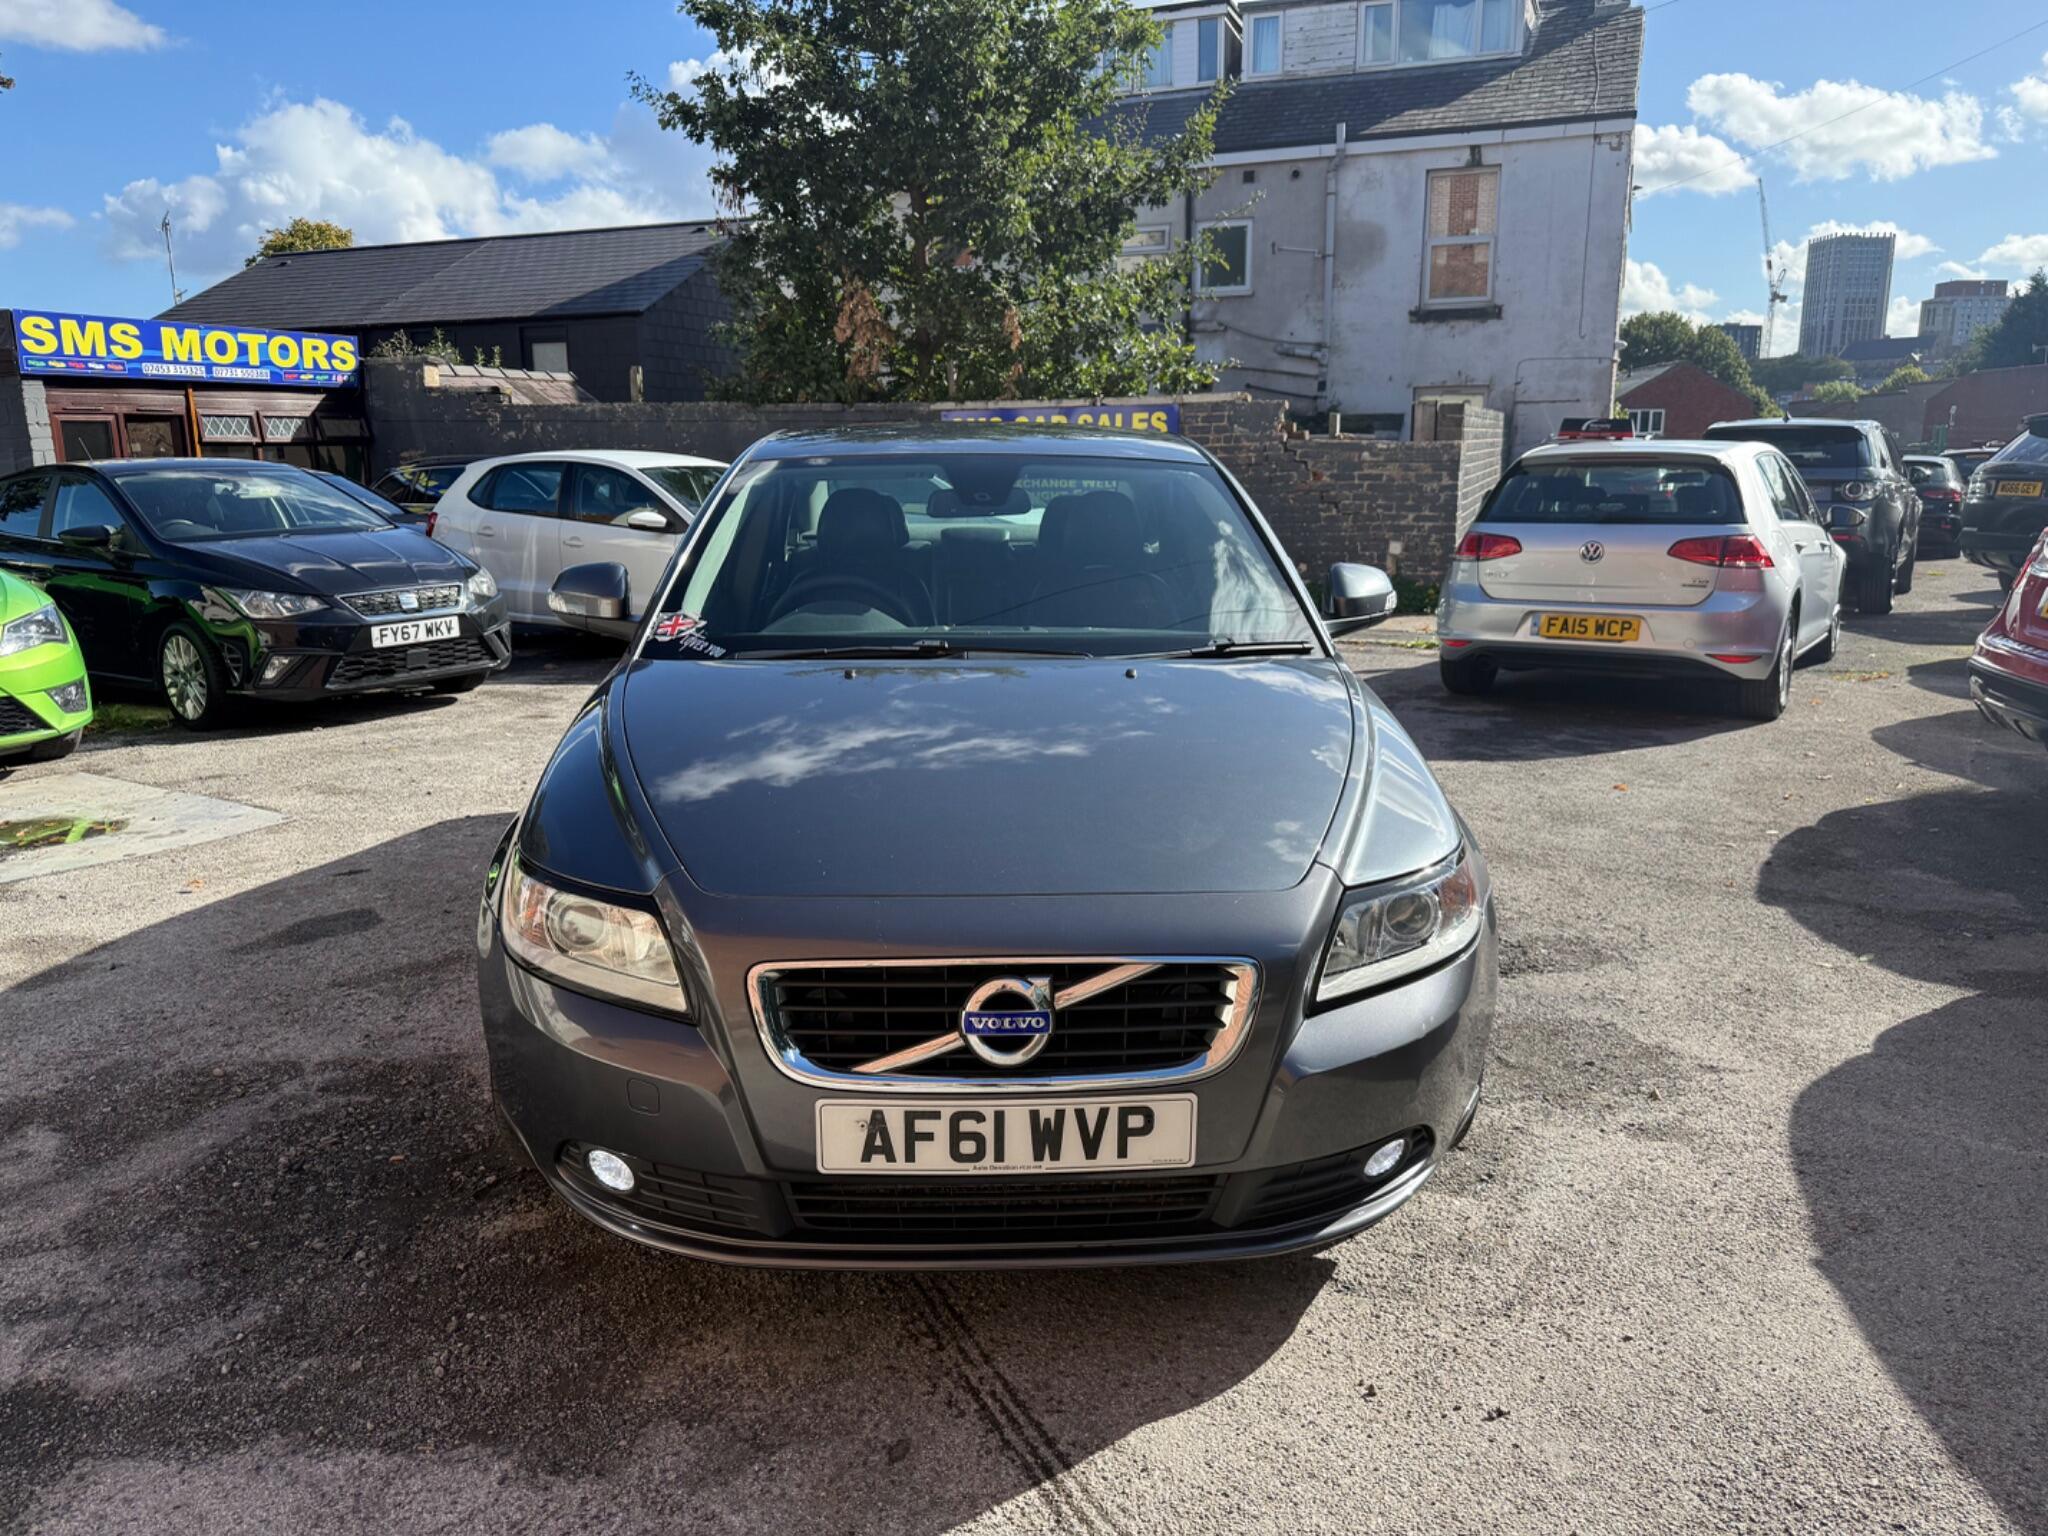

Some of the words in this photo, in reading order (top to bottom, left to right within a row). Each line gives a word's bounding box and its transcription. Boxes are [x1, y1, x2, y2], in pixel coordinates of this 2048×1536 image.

[20, 316, 143, 359] SMS
[160, 327, 356, 371] MOTORS
[379, 624, 420, 644] FY67
[424, 619, 453, 638] WKV
[1546, 617, 1588, 634] FA15
[1594, 619, 1632, 637] WCP
[969, 1017, 1045, 1029] VOLVO
[860, 1109, 1006, 1163] AF61
[1028, 1106, 1156, 1162] WVP
